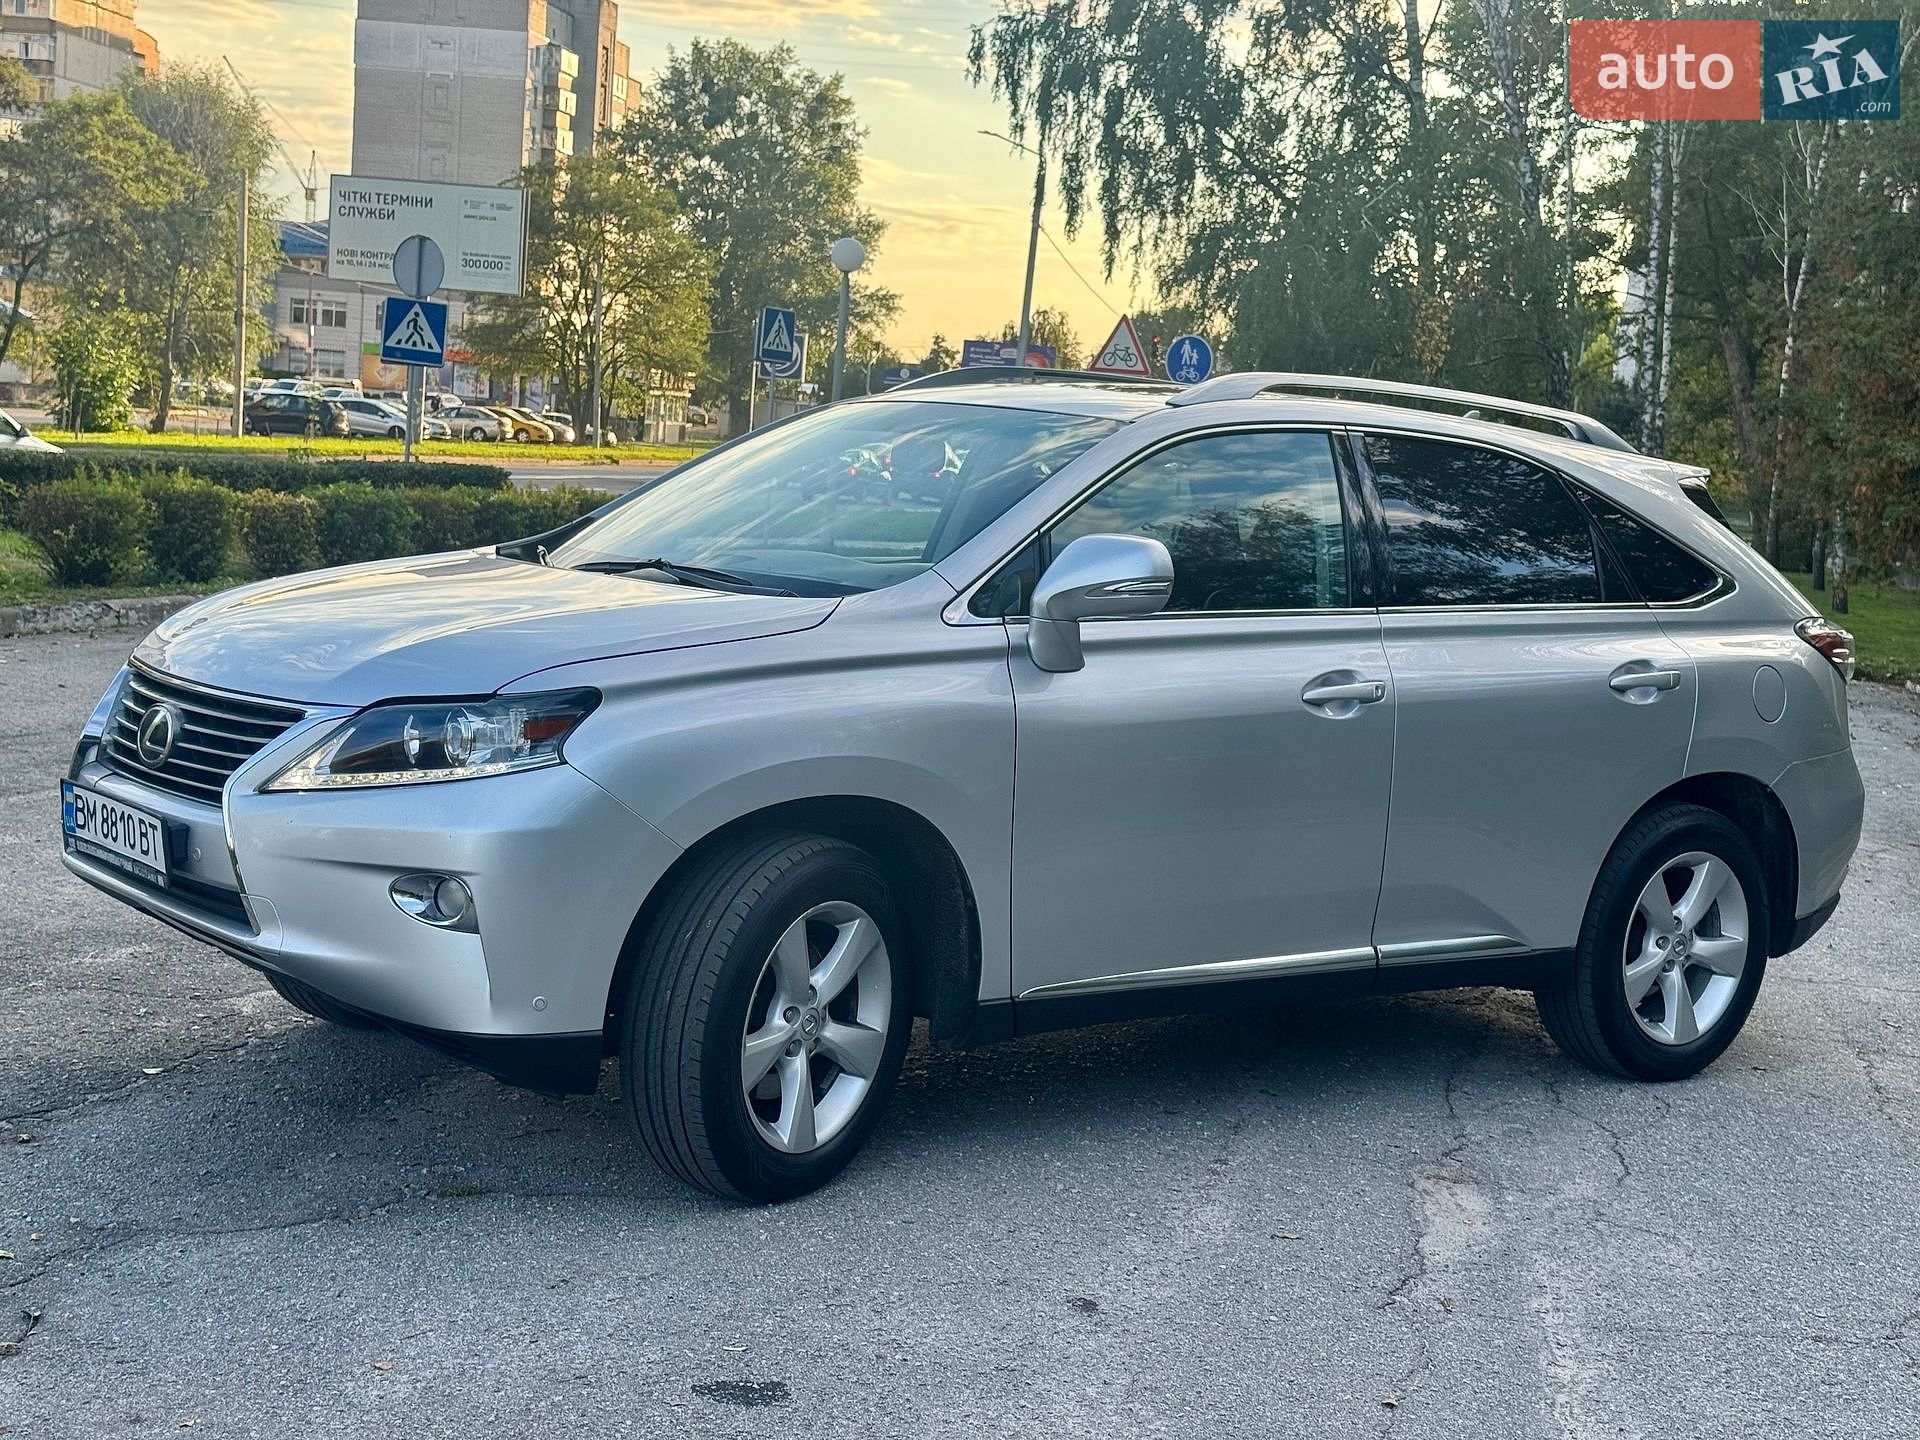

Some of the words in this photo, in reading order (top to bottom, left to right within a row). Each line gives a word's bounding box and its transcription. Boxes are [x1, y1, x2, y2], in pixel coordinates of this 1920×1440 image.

[338, 190, 371, 204] ЧІТКІ
[375, 192, 434, 209] ТЕРМІНИ
[338, 205, 396, 221] СЛУЖБИ
[336, 248, 359, 258] НОВІ
[101, 803, 136, 851] 8810
